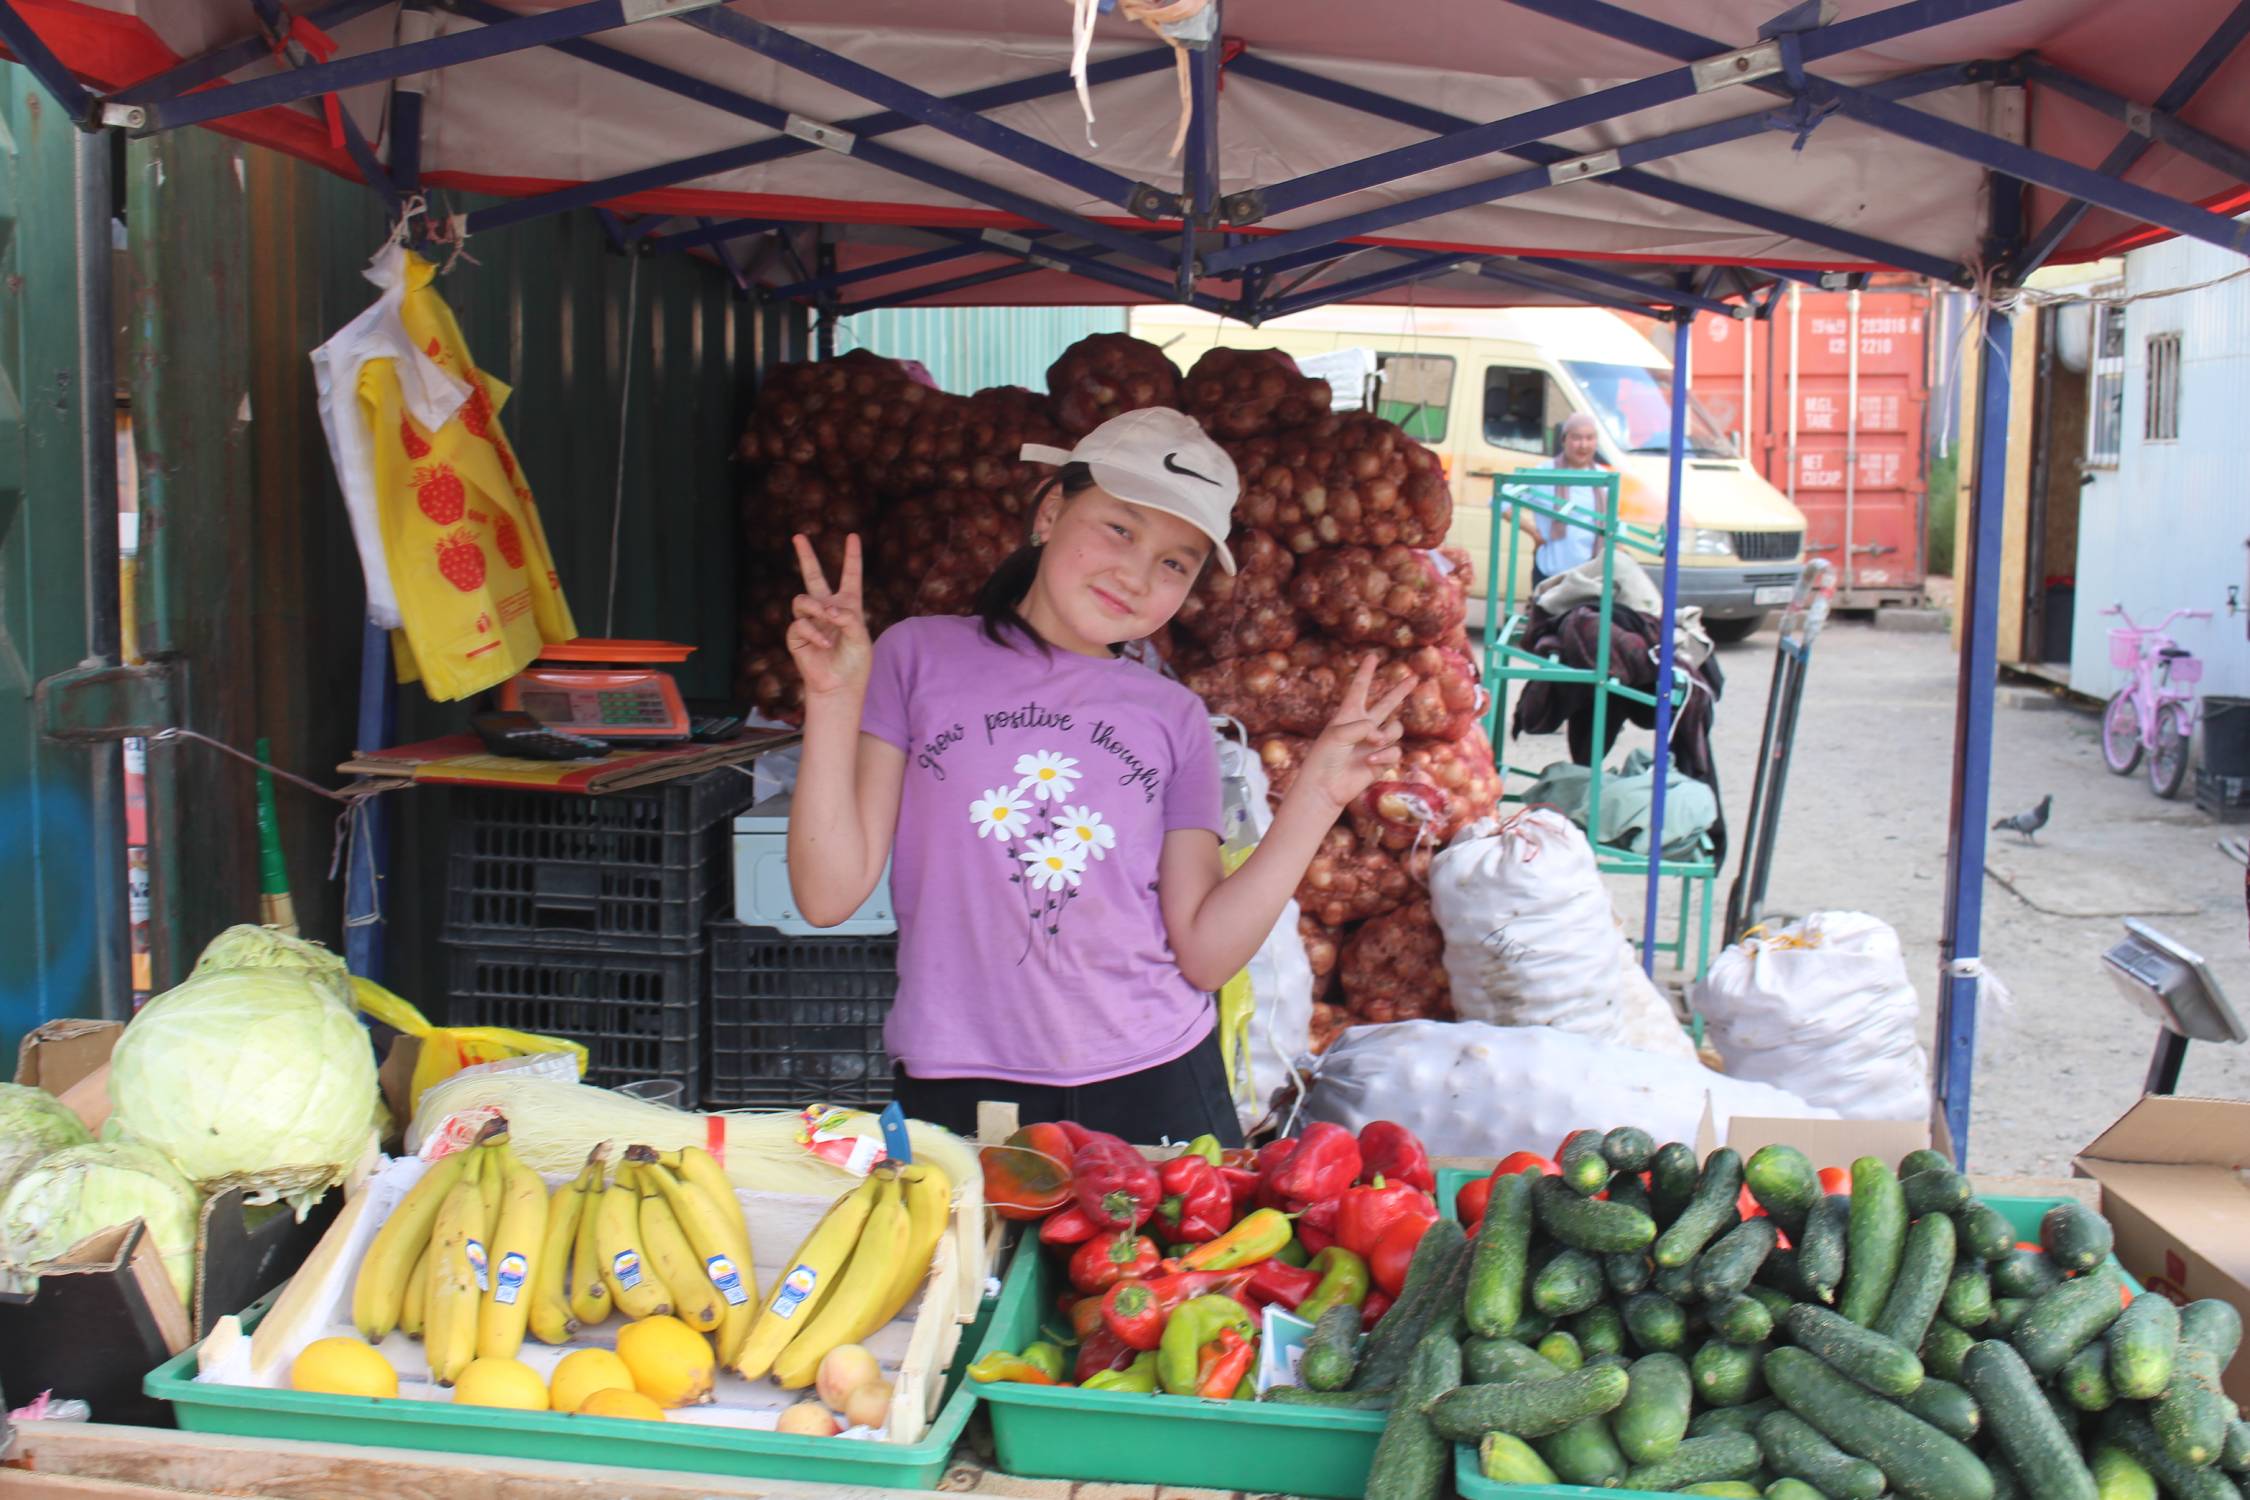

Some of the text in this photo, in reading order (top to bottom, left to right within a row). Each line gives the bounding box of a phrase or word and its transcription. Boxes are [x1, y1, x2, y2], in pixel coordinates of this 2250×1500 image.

[917, 702, 1159, 803] grow positive thoughts
